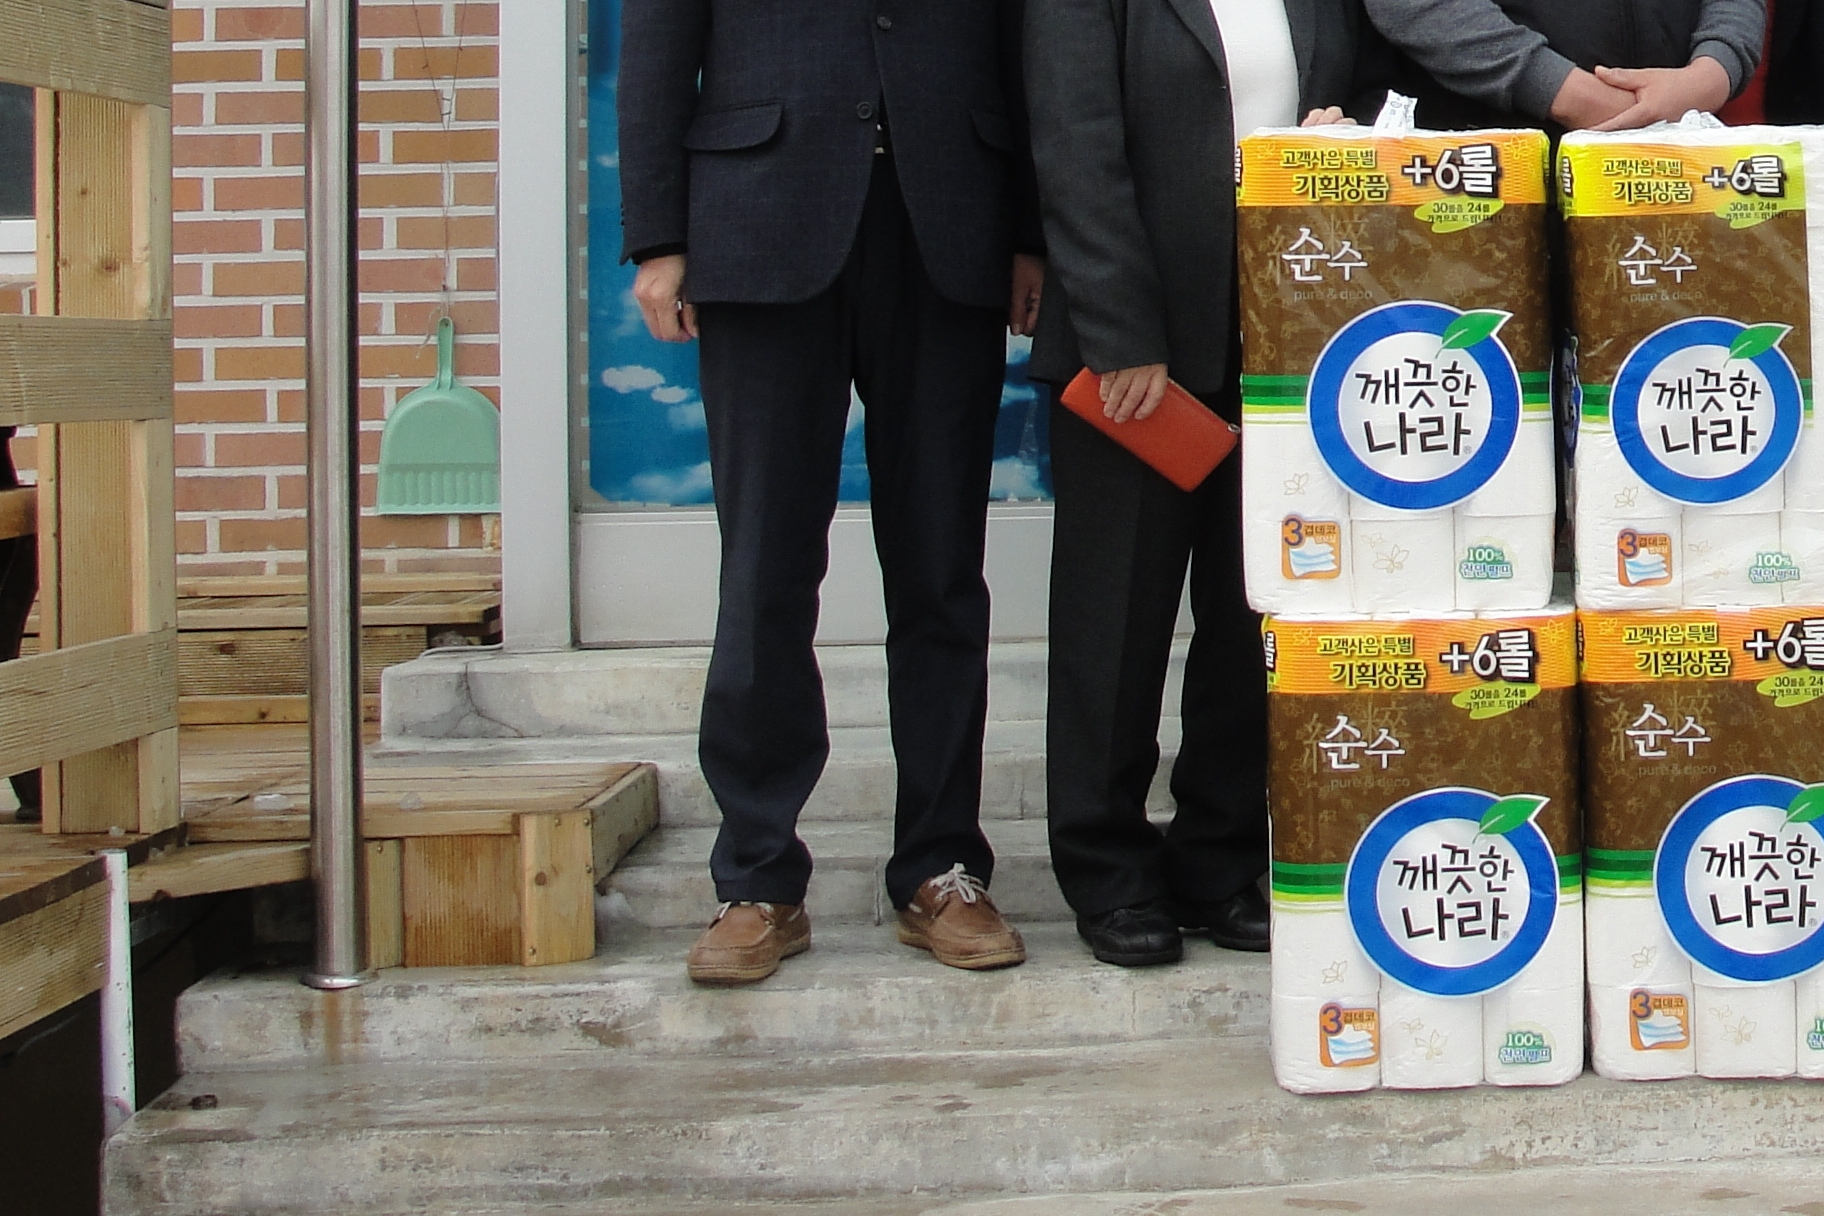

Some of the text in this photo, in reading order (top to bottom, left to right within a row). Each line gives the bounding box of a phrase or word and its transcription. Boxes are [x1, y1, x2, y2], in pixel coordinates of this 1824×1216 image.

[1281, 150, 1342, 169] 고객사은
[1602, 159, 1652, 175] 고객사은
[1293, 173, 1390, 202] 기획상품
[1613, 180, 1693, 204] 기획상품
[1281, 227, 1368, 282] 순수
[1618, 235, 1698, 286] 순수
[1355, 357, 1478, 409] 깨끗한
[1652, 367, 1761, 412] 깨끗한
[1363, 411, 1472, 456] 나라
[1660, 415, 1758, 456] 나라
[1317, 636, 1379, 655] 고객사은
[1622, 625, 1684, 644] 고객사은
[1330, 660, 1427, 688] 기획상품
[1635, 648, 1732, 678] 기획상품
[1318, 714, 1406, 771] 순수
[1625, 703, 1712, 757] 순수
[1393, 843, 1515, 895] 깨끗한
[1700, 831, 1822, 881] 깨끗한
[1401, 897, 1510, 941] 나라
[1709, 884, 1817, 928] 나라
